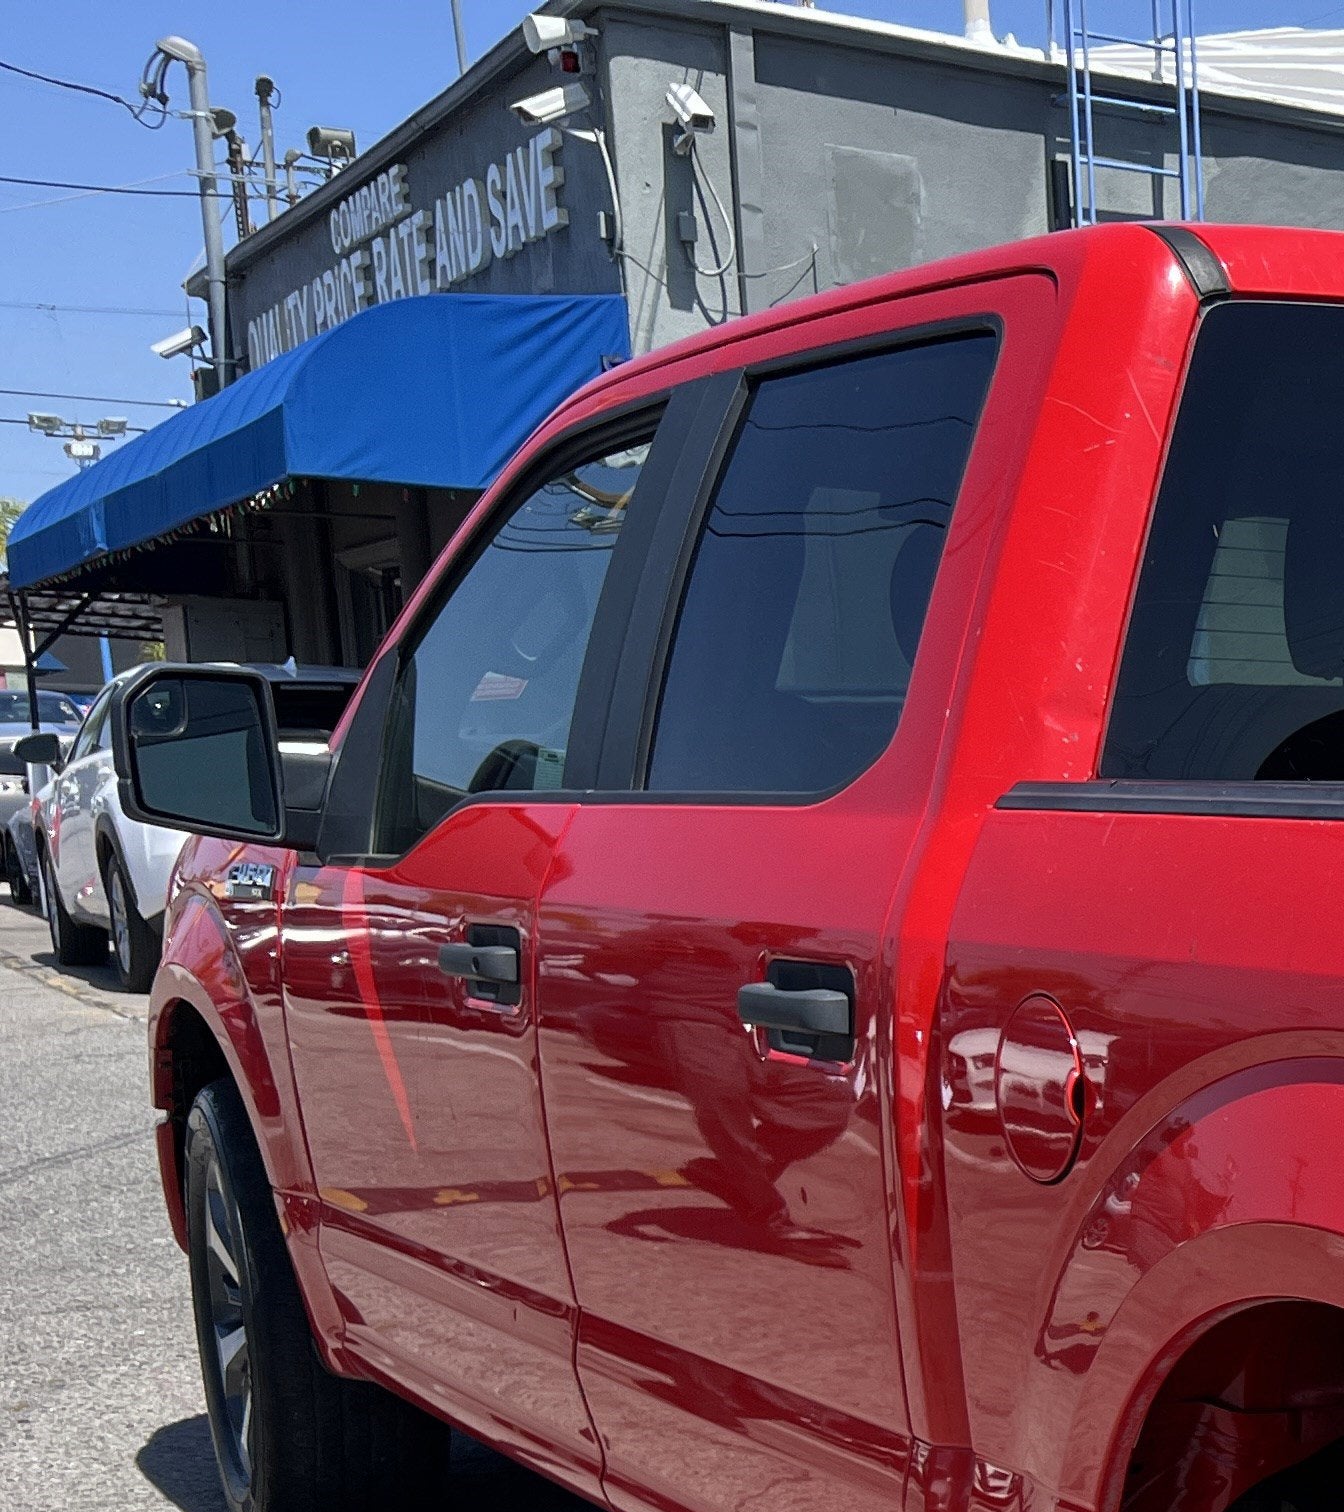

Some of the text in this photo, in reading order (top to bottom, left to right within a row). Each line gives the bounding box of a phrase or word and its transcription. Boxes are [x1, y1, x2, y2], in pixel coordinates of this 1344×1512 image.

[330, 164, 406, 254] COMPARE
[372, 209, 432, 304] RATE
[435, 179, 485, 290] AND
[486, 127, 564, 260] SAVE
